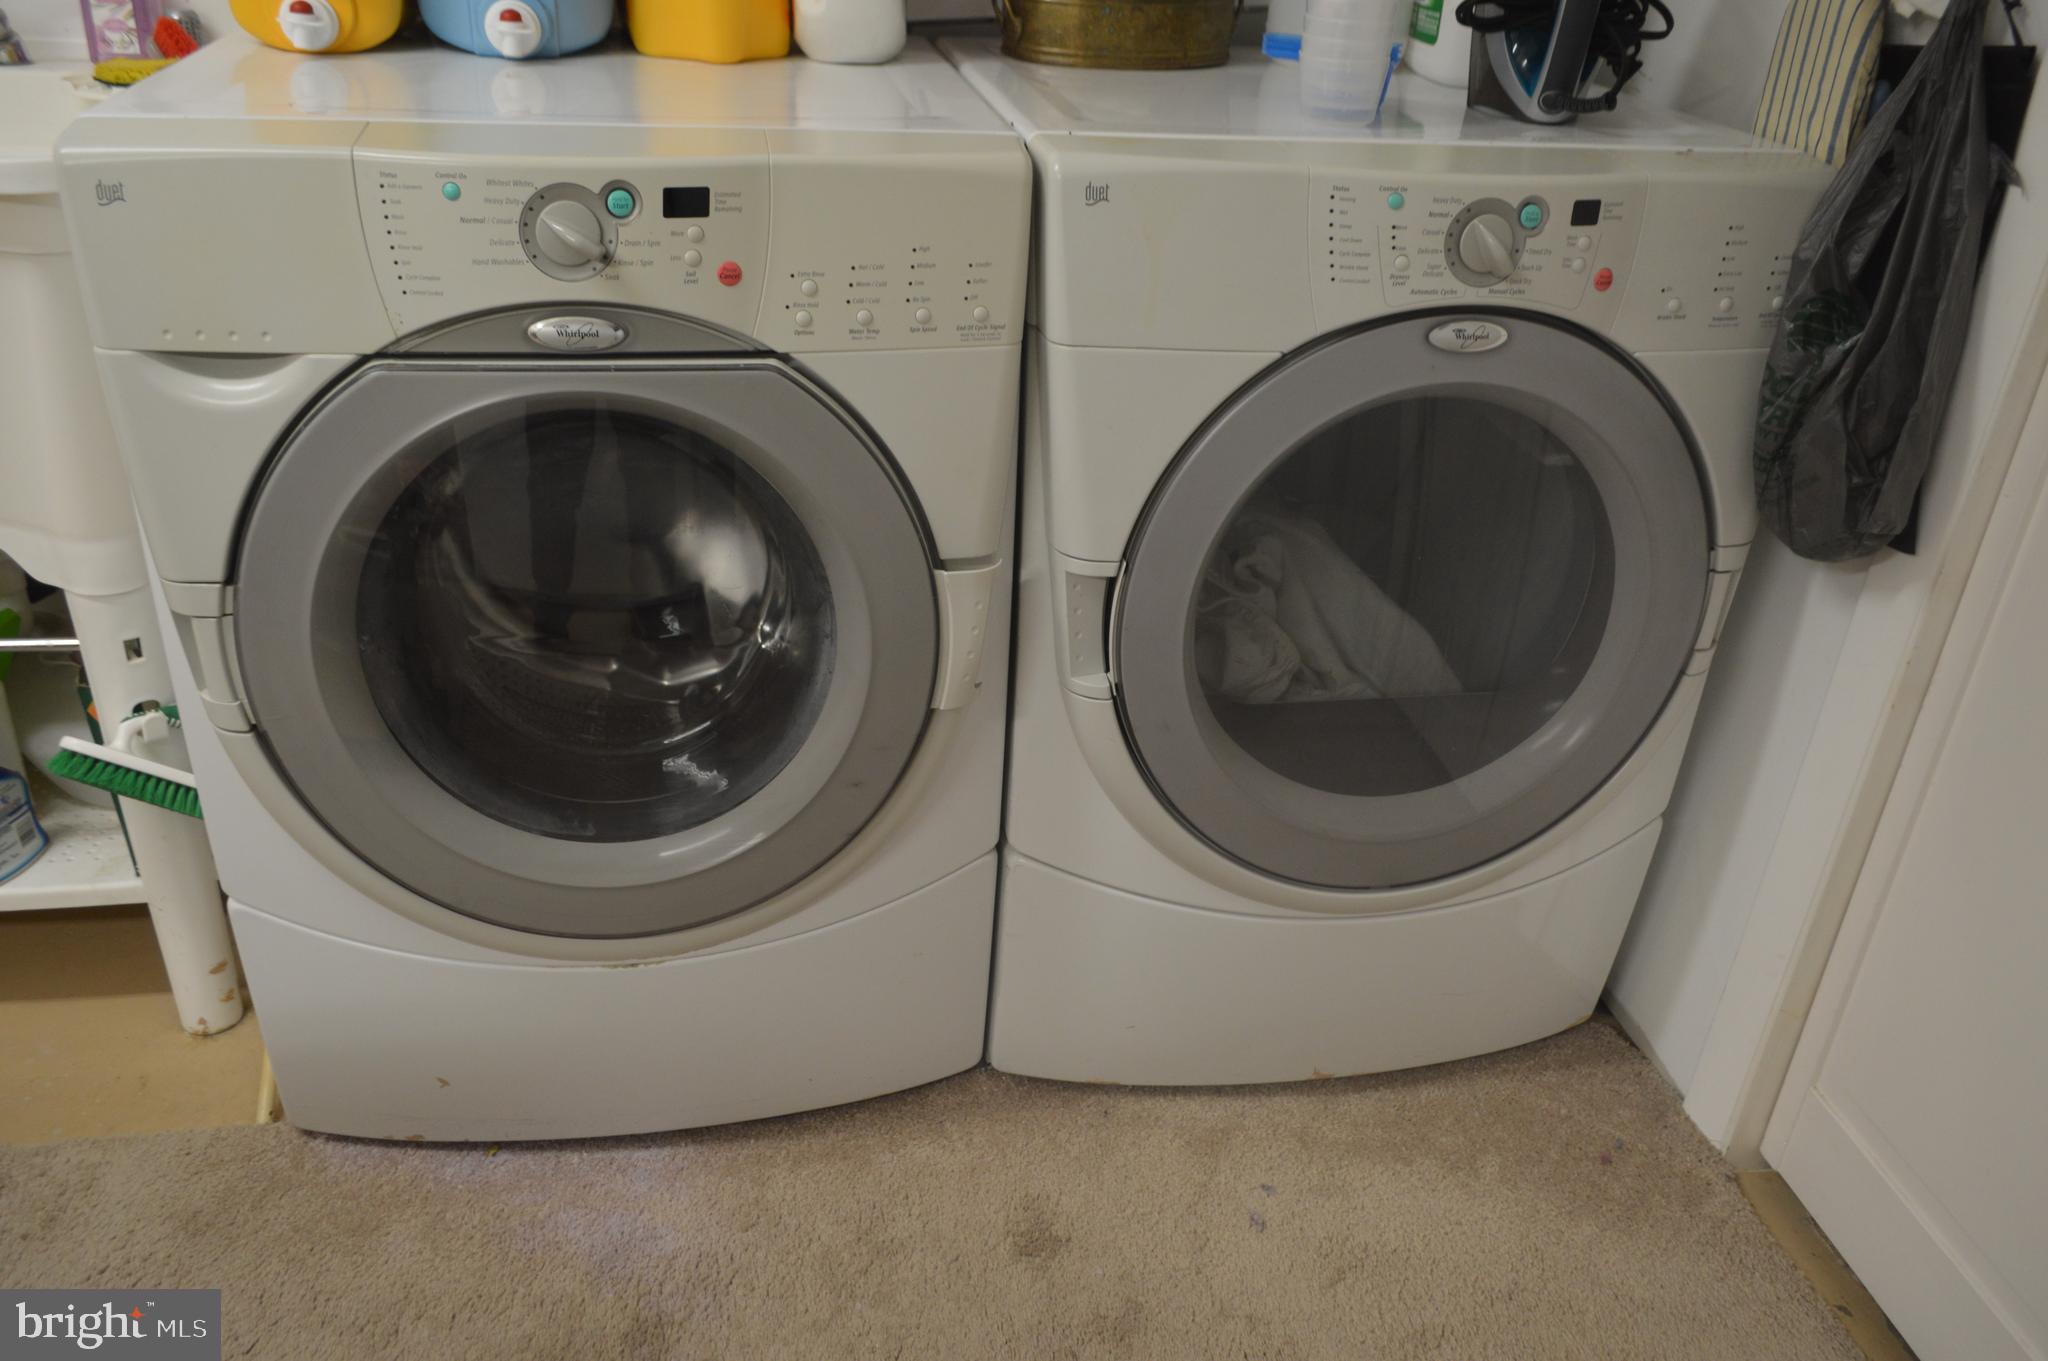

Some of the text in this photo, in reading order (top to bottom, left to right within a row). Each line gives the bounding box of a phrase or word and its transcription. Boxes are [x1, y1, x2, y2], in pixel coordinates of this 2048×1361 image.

[513, 180, 534, 188] Whites
[96, 180, 127, 206] duet
[1085, 180, 1110, 207] duet
[612, 202, 629, 210] Start
[459, 216, 486, 225] Normal
[491, 217, 514, 225] Casual
[489, 239, 515, 247] Delicate
[647, 240, 661, 248] Spin
[471, 258, 525, 266] Hand Washables
[1409, 288, 1439, 296] Automatic
[556, 328, 600, 340] Whirlpool
[1455, 332, 1490, 341] Whirlpool
